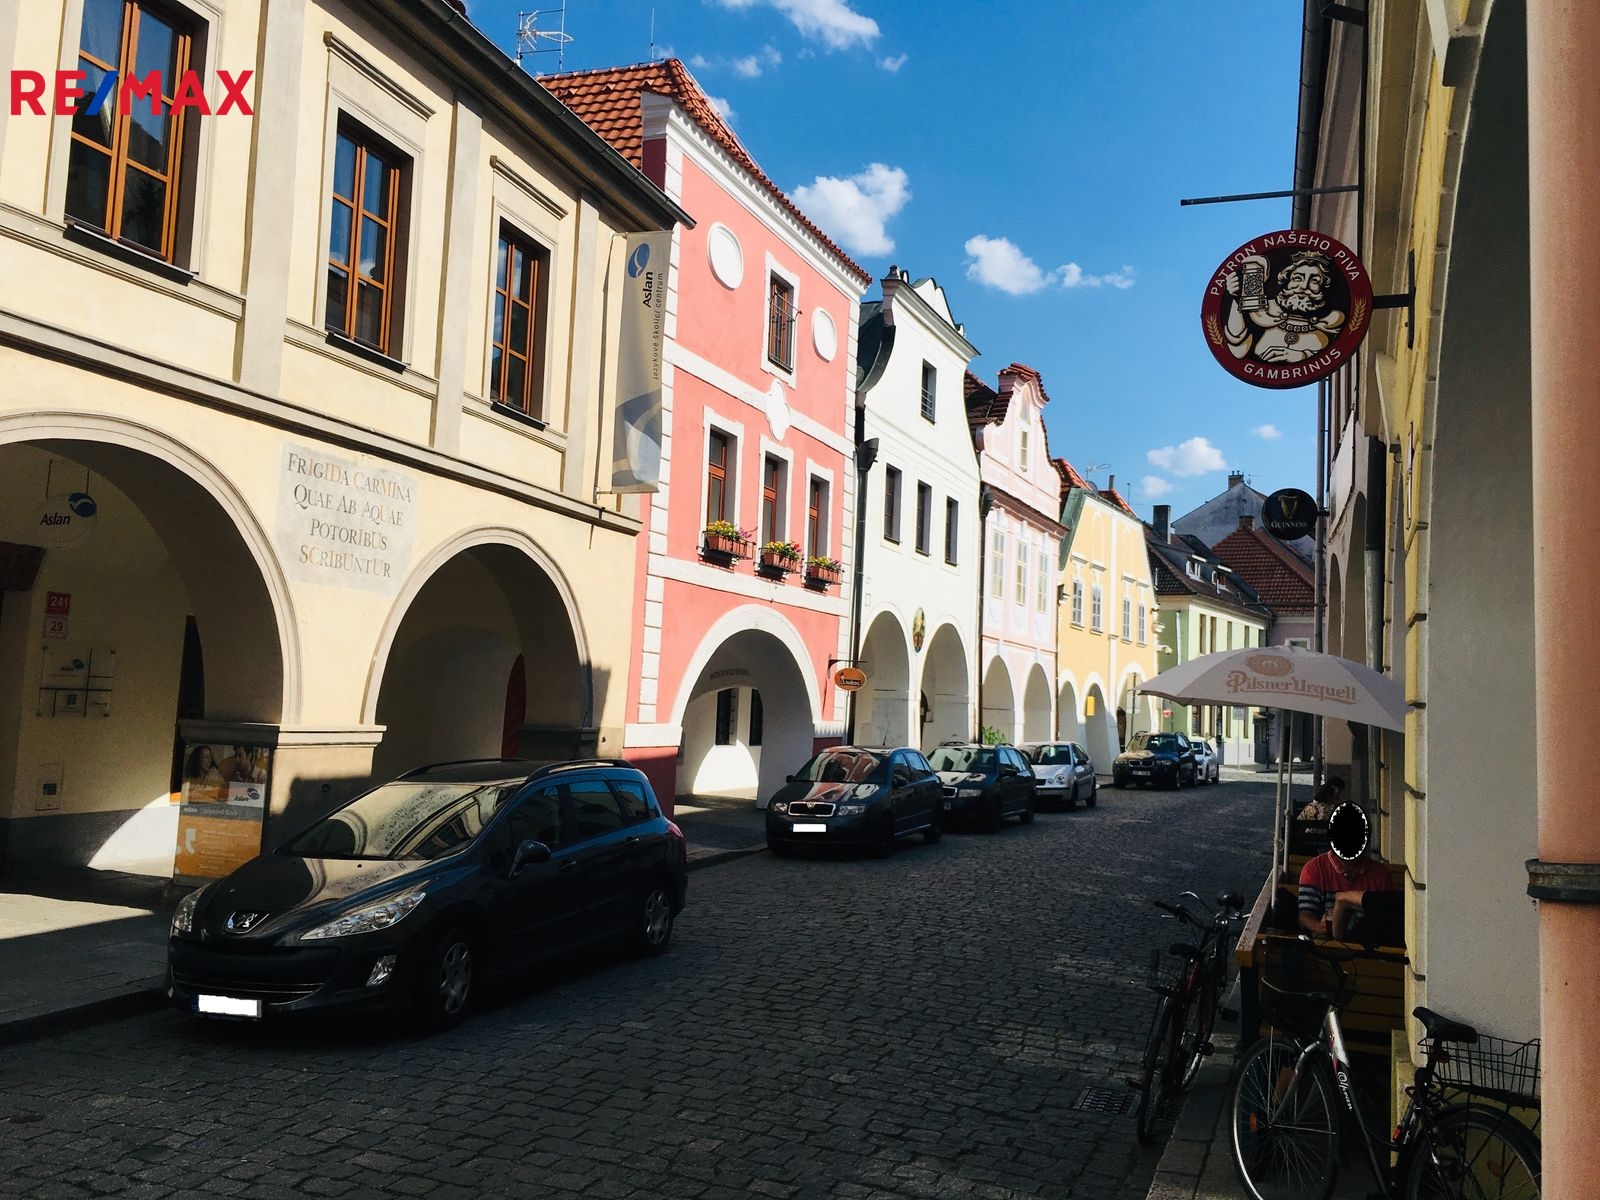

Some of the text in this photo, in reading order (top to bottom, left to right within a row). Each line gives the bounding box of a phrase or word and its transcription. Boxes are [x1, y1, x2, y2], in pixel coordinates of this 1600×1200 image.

[1210, 231, 1360, 296] PATRON NAŠEHO PIVA
[642, 271, 654, 308] Aslan
[655, 273, 664, 308] centrum
[652, 342, 660, 380] jazykové
[1243, 348, 1341, 379] GAMBRINUS
[288, 453, 411, 503] FRIGIDA CARMINA
[40, 512, 71, 526] Aslan
[294, 484, 403, 526] QUAE AB AQUAE
[310, 518, 387, 550] POTORIBUS
[1270, 520, 1308, 529] GUINNESS
[299, 545, 391, 578] SCRIBUNTUR
[50, 595, 69, 609] 241
[50, 620, 64, 632] 29
